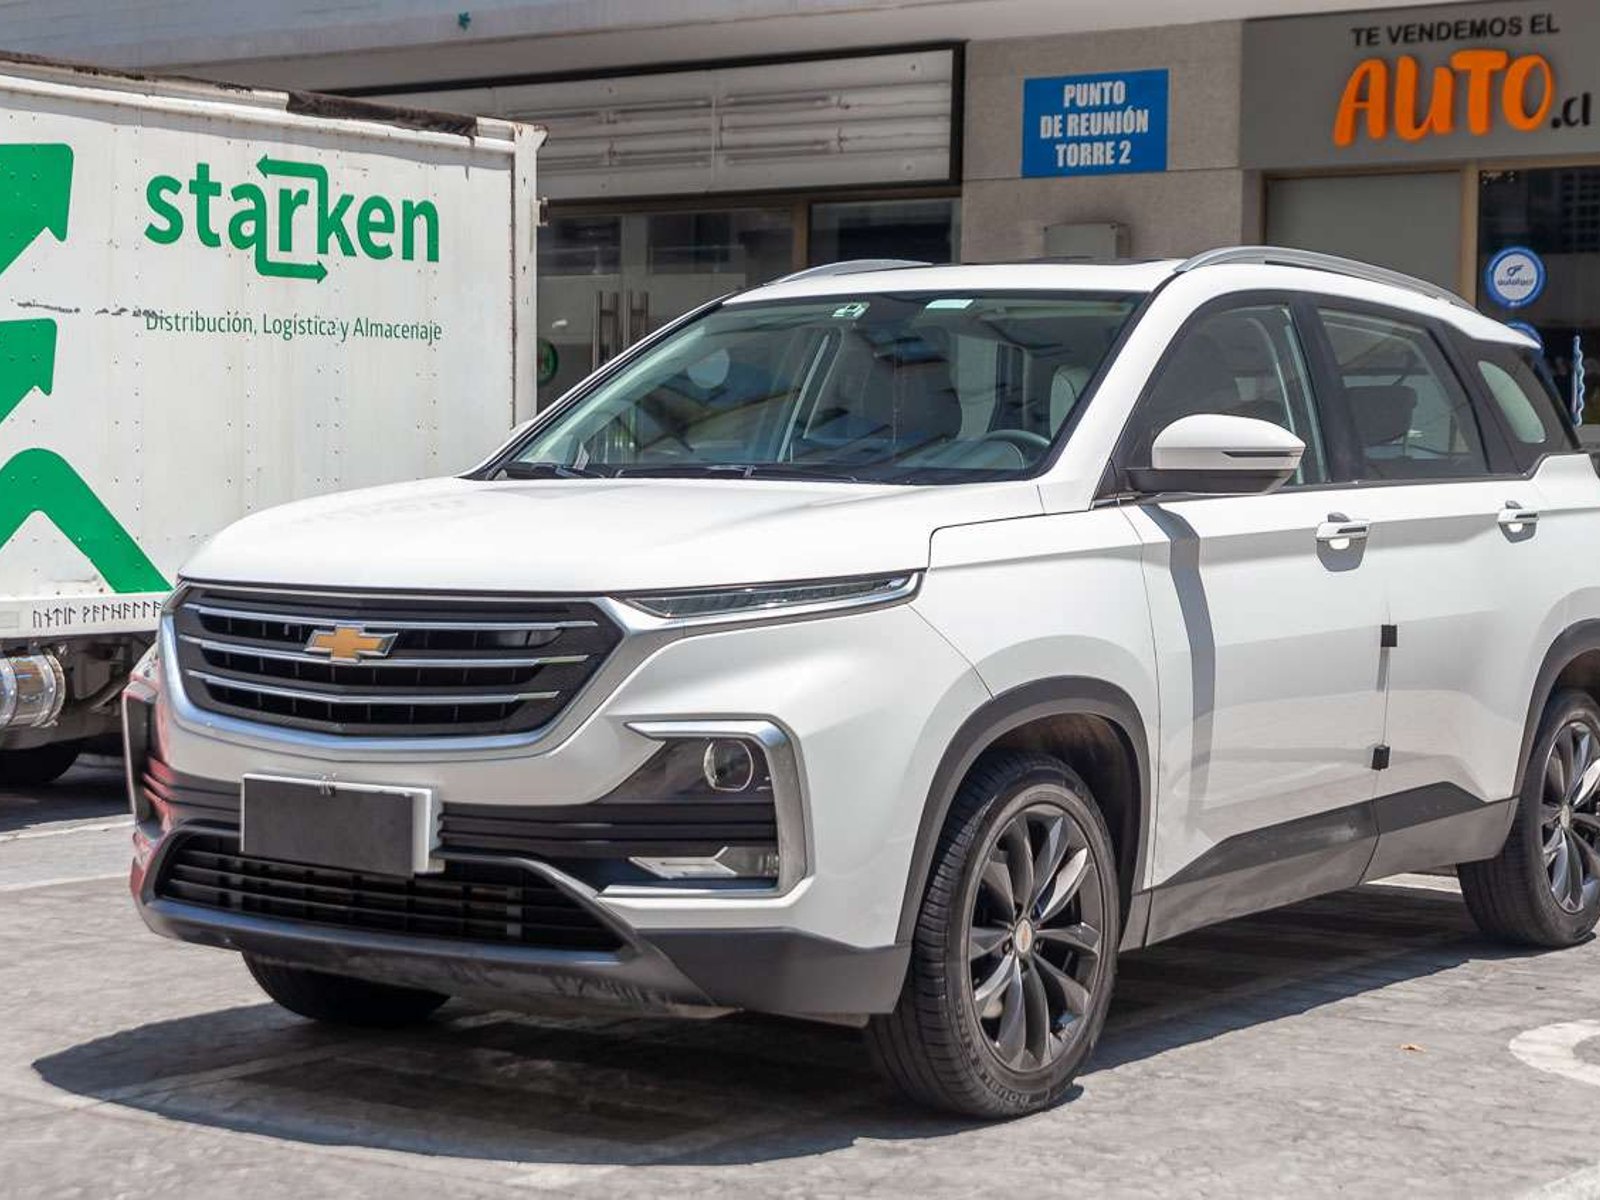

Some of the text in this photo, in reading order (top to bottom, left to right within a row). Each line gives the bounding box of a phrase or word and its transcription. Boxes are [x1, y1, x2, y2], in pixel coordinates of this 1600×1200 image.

[1351, 13, 1561, 46] TE VENDEMOS EL
[1063, 80, 1126, 108] PUNTO
[1040, 105, 1149, 139] DE REUNIÓN
[1055, 140, 1132, 167] TORRE 2
[144, 156, 439, 280] starken
[146, 309, 442, 346] Distribución, Logística y Almacenaje
